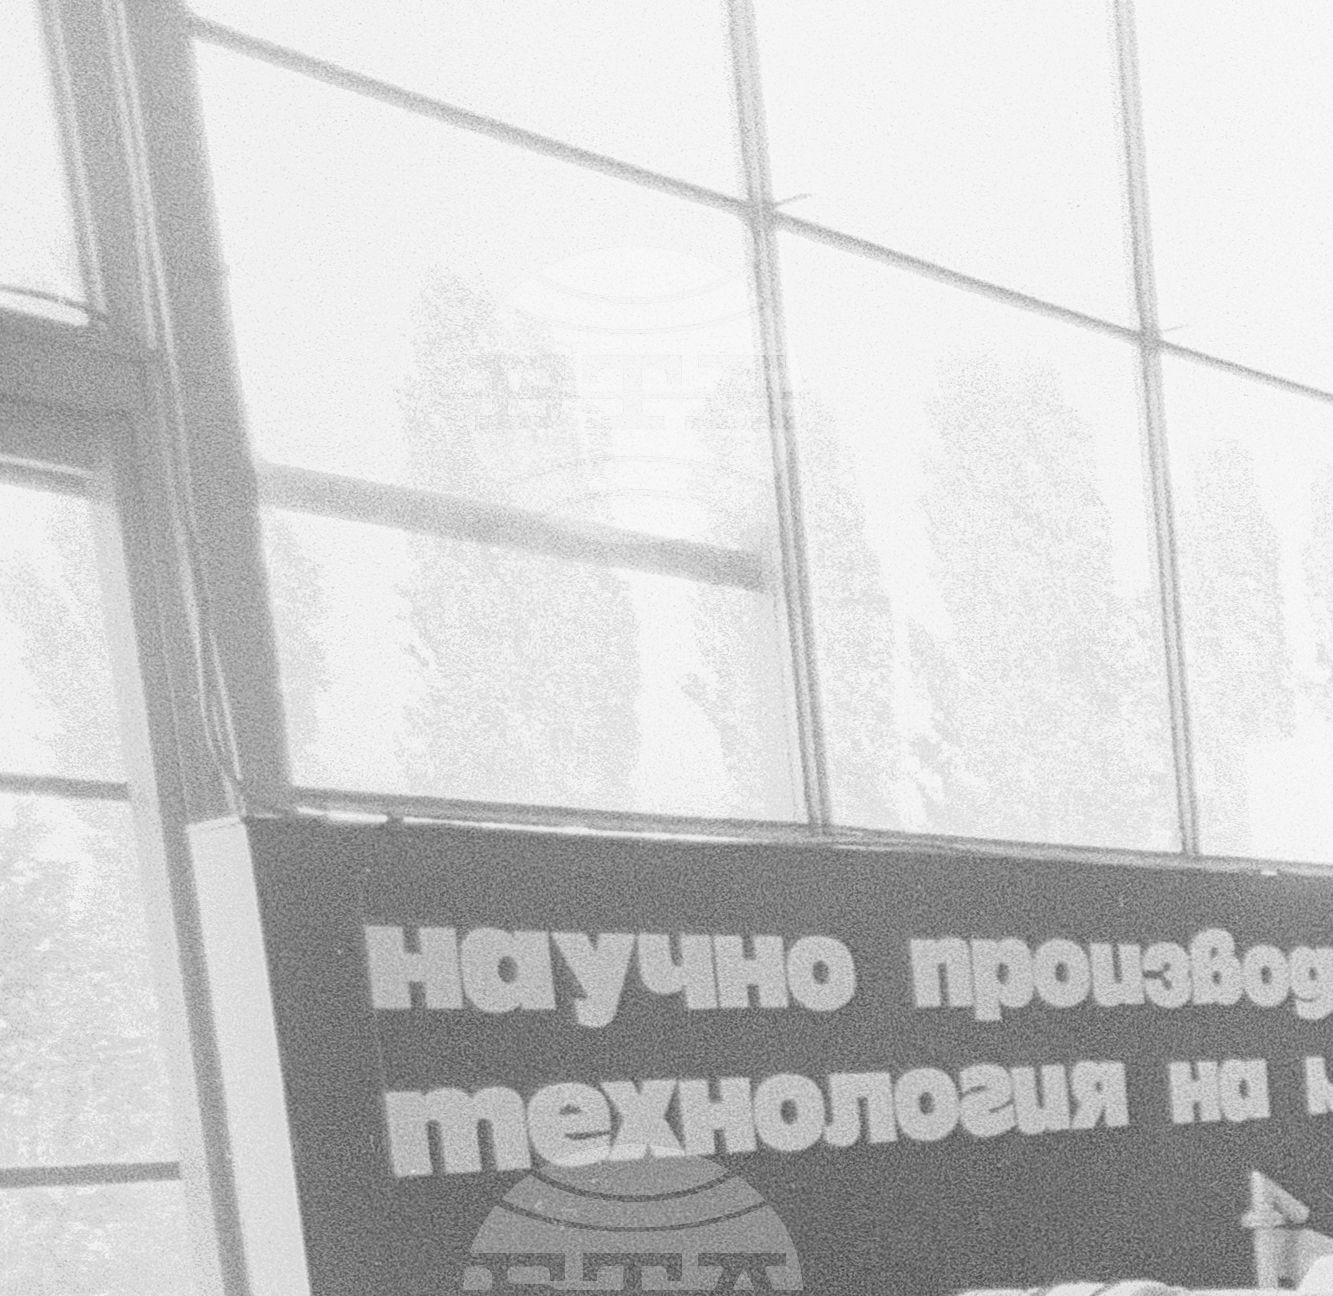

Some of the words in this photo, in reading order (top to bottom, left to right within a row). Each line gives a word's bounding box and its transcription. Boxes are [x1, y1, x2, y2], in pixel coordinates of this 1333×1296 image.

[362, 923, 857, 1028] научно
[381, 1058, 1129, 1178] технология
[1166, 1056, 1270, 1124] на
